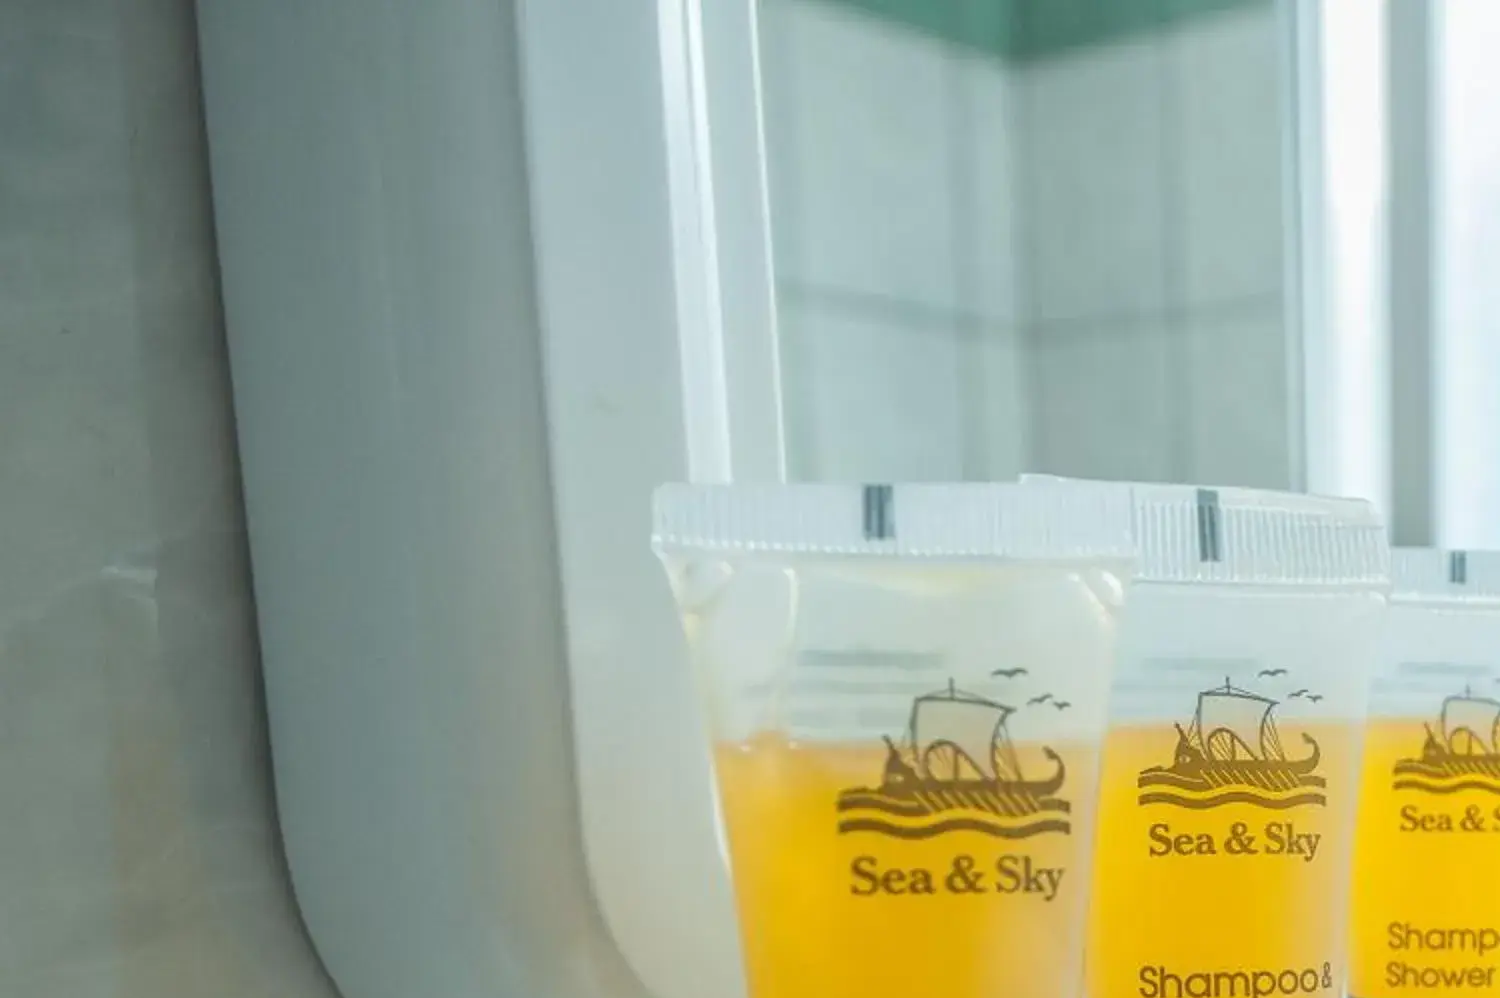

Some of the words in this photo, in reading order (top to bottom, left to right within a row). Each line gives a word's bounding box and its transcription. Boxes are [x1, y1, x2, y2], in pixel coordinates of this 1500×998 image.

[1400, 804, 1453, 833] Sea
[1460, 803, 1486, 833] &
[1149, 823, 1216, 857] Sea
[1223, 821, 1259, 855] &
[1264, 821, 1321, 862] Sky
[850, 855, 935, 896] Sea
[945, 854, 988, 895] &
[995, 854, 1065, 902] Sky
[1385, 960, 1496, 988] Shower
